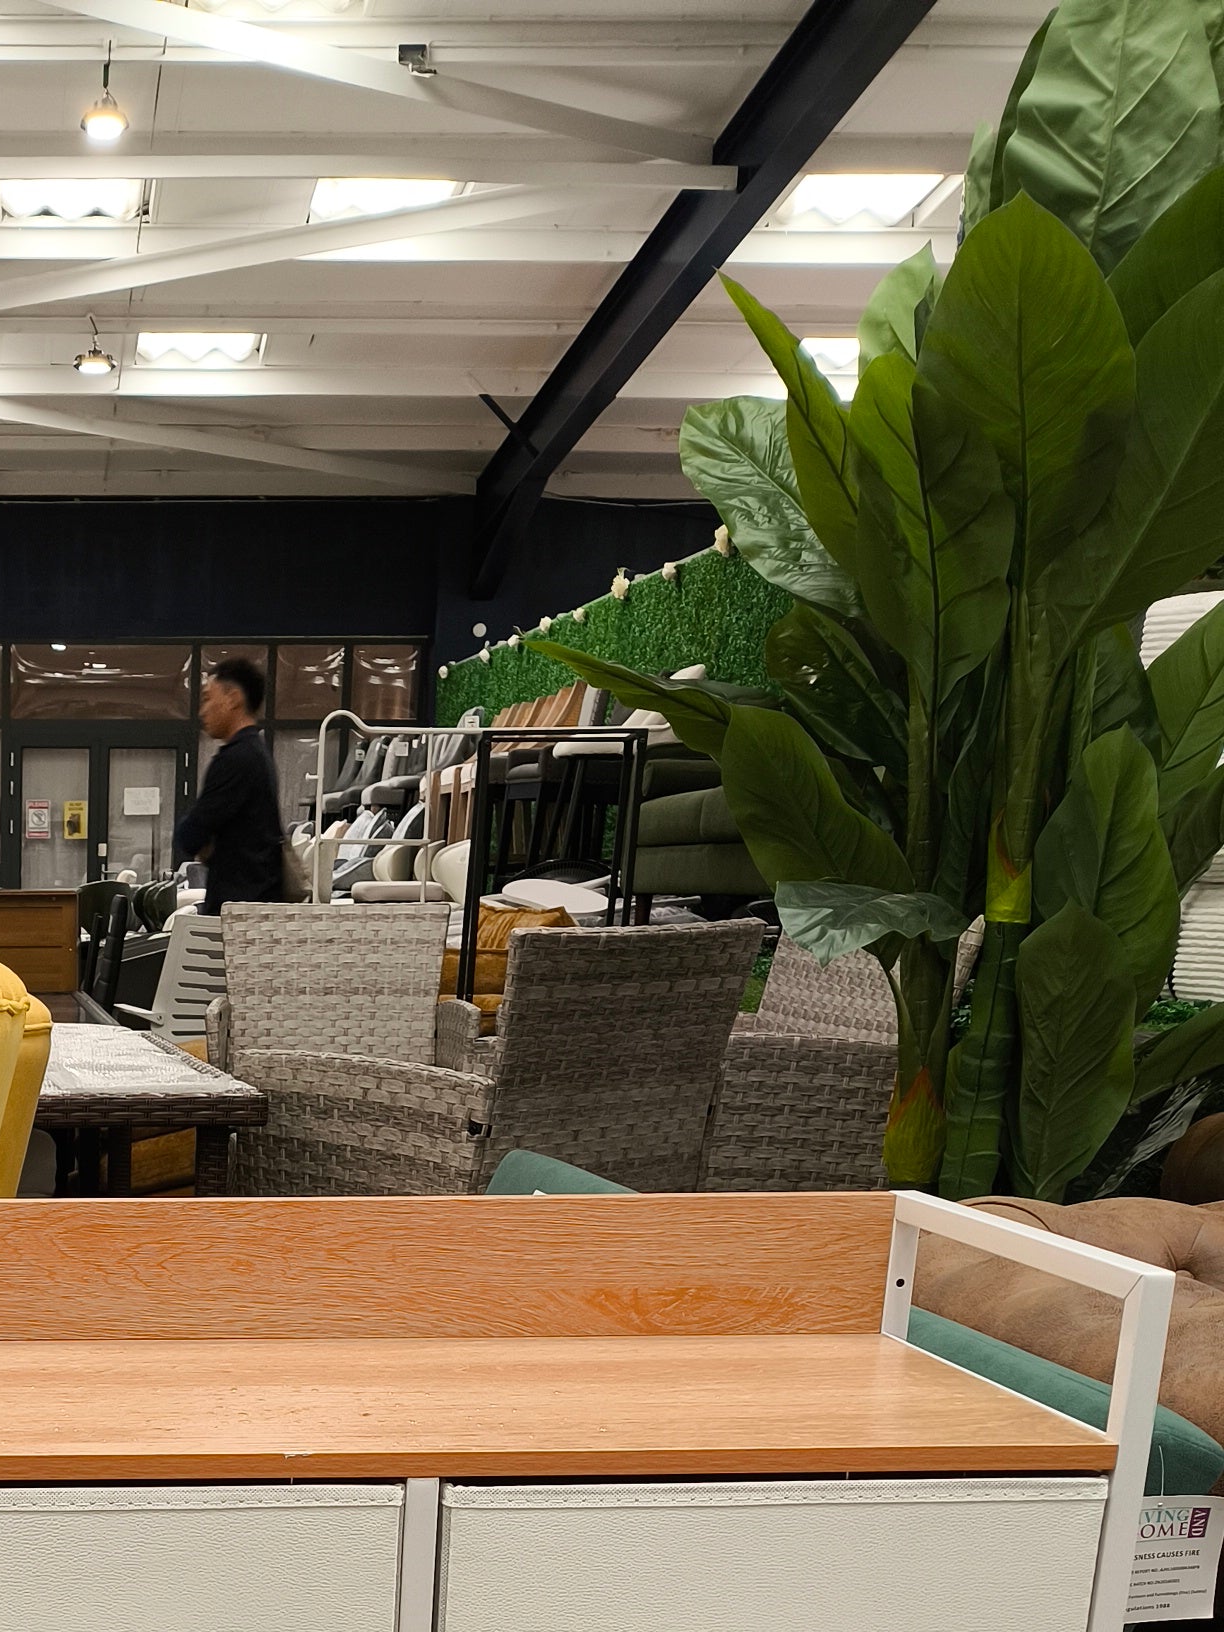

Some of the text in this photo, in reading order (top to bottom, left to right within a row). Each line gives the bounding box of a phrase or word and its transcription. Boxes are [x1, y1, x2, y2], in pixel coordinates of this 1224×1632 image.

[1143, 1509, 1190, 1523] VING
[1140, 1522, 1188, 1539] OME
[1133, 1549, 1200, 1561] SNESS CAUSES FIRE
